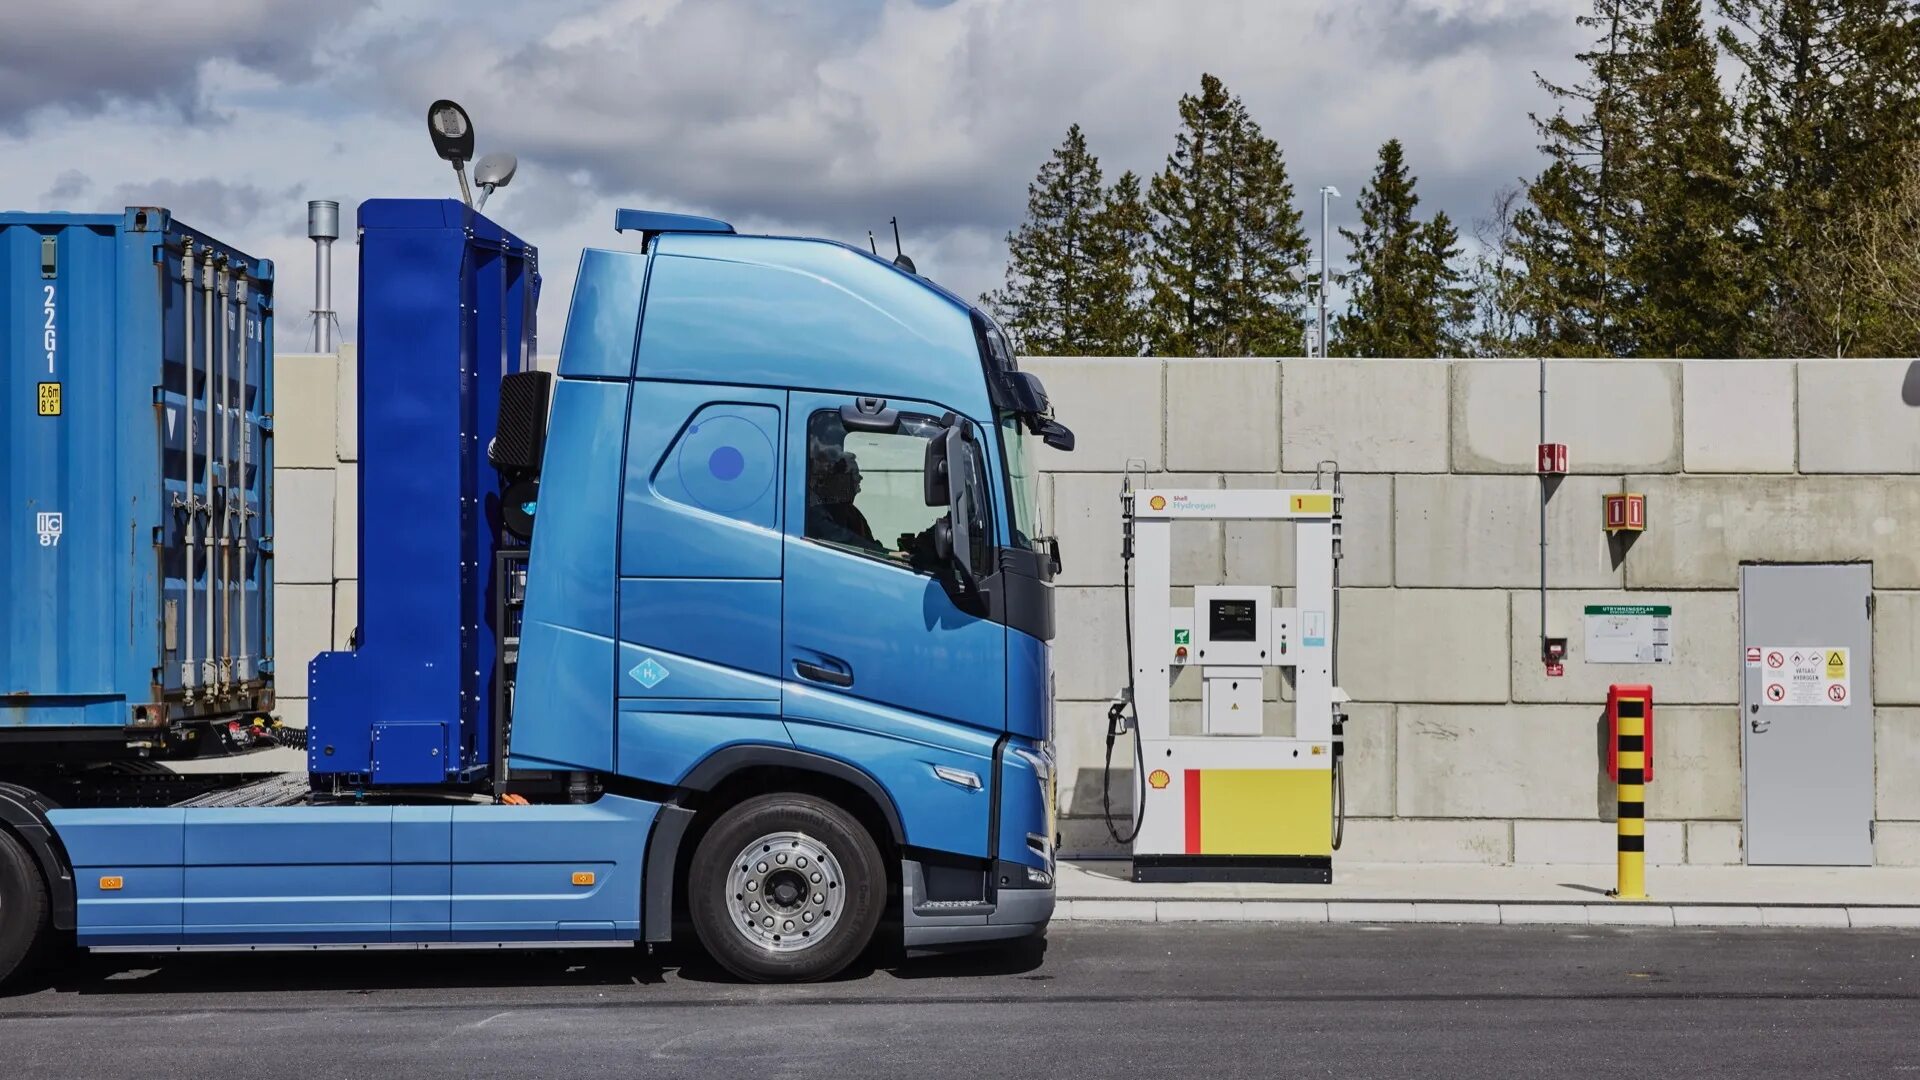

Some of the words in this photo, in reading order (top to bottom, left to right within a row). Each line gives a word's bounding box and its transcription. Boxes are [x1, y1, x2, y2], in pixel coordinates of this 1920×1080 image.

[44, 285, 56, 374] 22G1
[41, 385, 59, 398] 2.6m
[1173, 501, 1216, 511] Hydrogen
[1297, 498, 1302, 509] 1
[40, 534, 60, 546] 87
